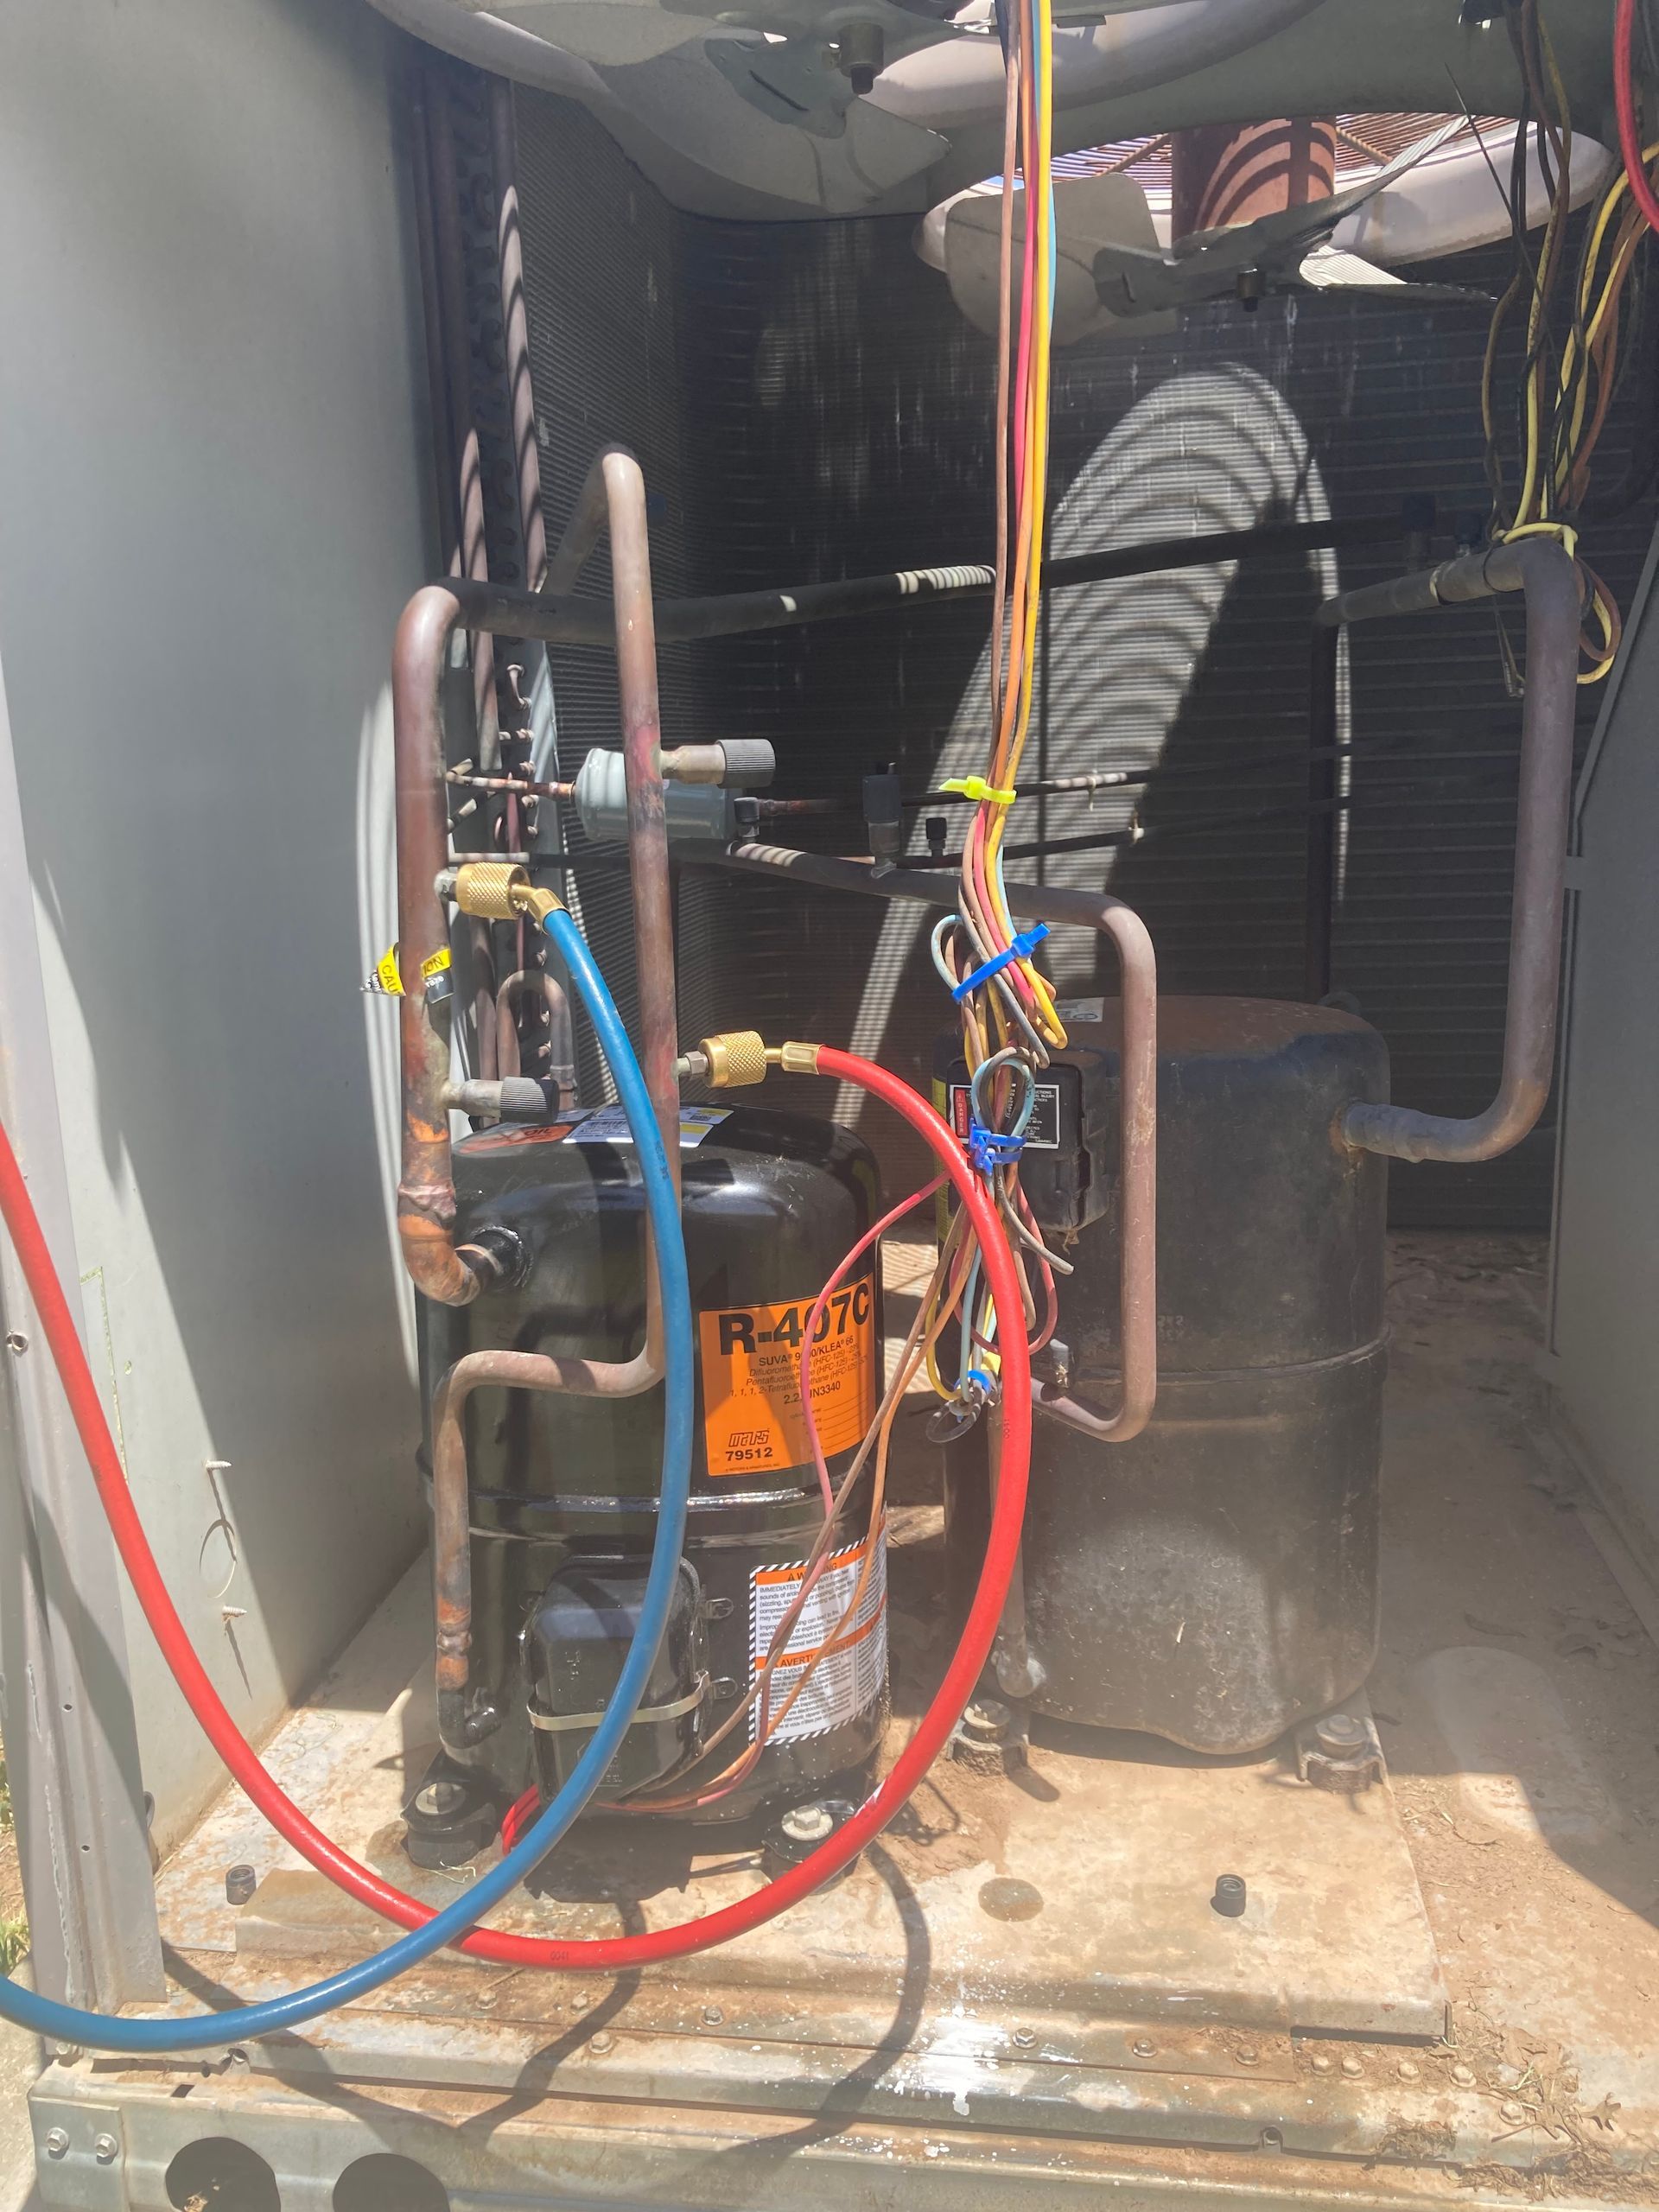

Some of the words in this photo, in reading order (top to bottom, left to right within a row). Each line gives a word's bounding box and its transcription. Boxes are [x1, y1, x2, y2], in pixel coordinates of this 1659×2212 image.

[718, 1282, 870, 1356] R-407C
[725, 1447, 773, 1461] 79512
[760, 1583, 801, 1592] IMMEDIATELY
[760, 1606, 788, 1615] compresso
